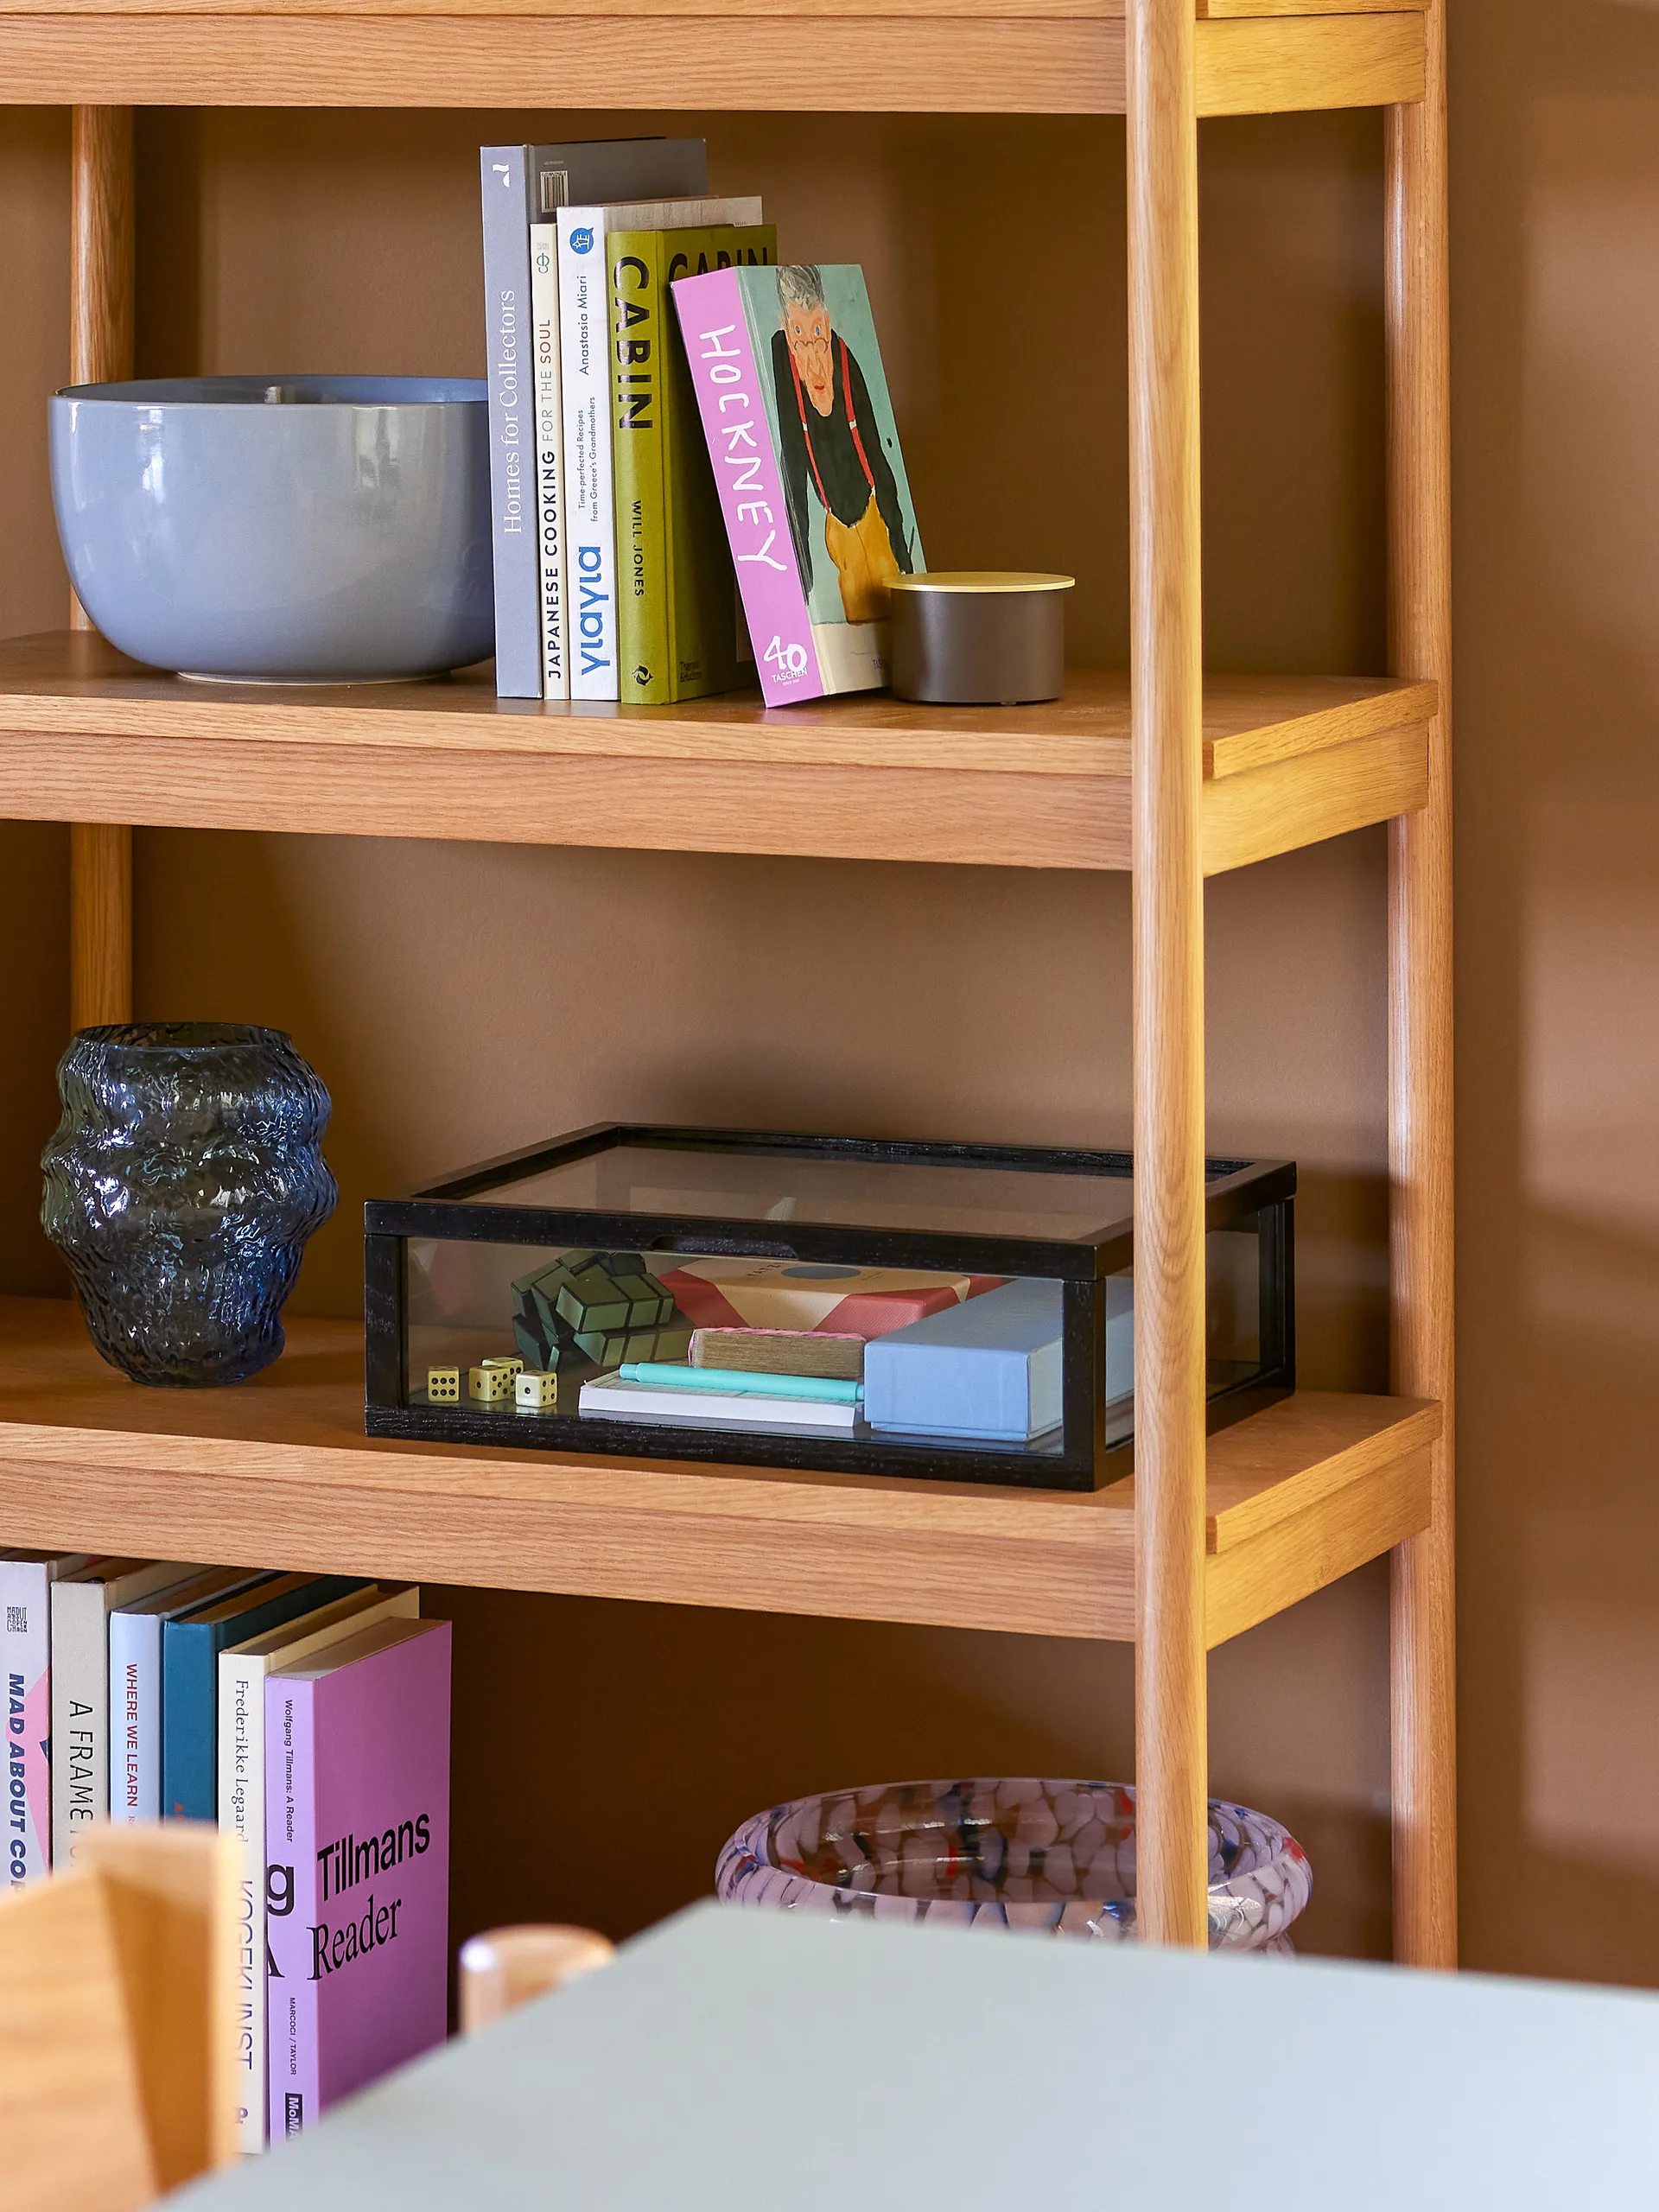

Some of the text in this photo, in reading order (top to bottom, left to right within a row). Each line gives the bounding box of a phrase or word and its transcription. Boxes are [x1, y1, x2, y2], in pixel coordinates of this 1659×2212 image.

[576, 276, 589, 376] Anastasia Miari
[613, 256, 653, 429] CABIN
[498, 289, 522, 534] Homes for Collectors
[699, 324, 788, 571] HOCKNEY
[538, 319, 562, 679] JAPANESE COOKING FOR THE SOUL
[575, 409, 587, 509] Time-perfected Recipes
[588, 396, 599, 522] from Greece's Grandmothers
[632, 499, 645, 596] WILL JONES
[763, 635, 808, 671] 40
[771, 668, 808, 683] TASCHEN
[9, 1673, 25, 1735] MAD
[69, 1700, 93, 1718] A
[126, 1663, 138, 1721] WHERE
[283, 1700, 294, 1747] Wolfgang
[69, 1731, 94, 1821] FRAME
[126, 1725, 138, 1750] WE
[126, 1753, 138, 1807] LEARN
[231, 1679, 249, 1843] Frederikke Legaard
[285, 1749, 294, 1794] Tillmans:
[10, 1741, 26, 1833] ABOUT
[286, 1806, 295, 1843] Reader
[317, 1813, 430, 1901] Tillmans
[306, 1893, 402, 1980] Reader
